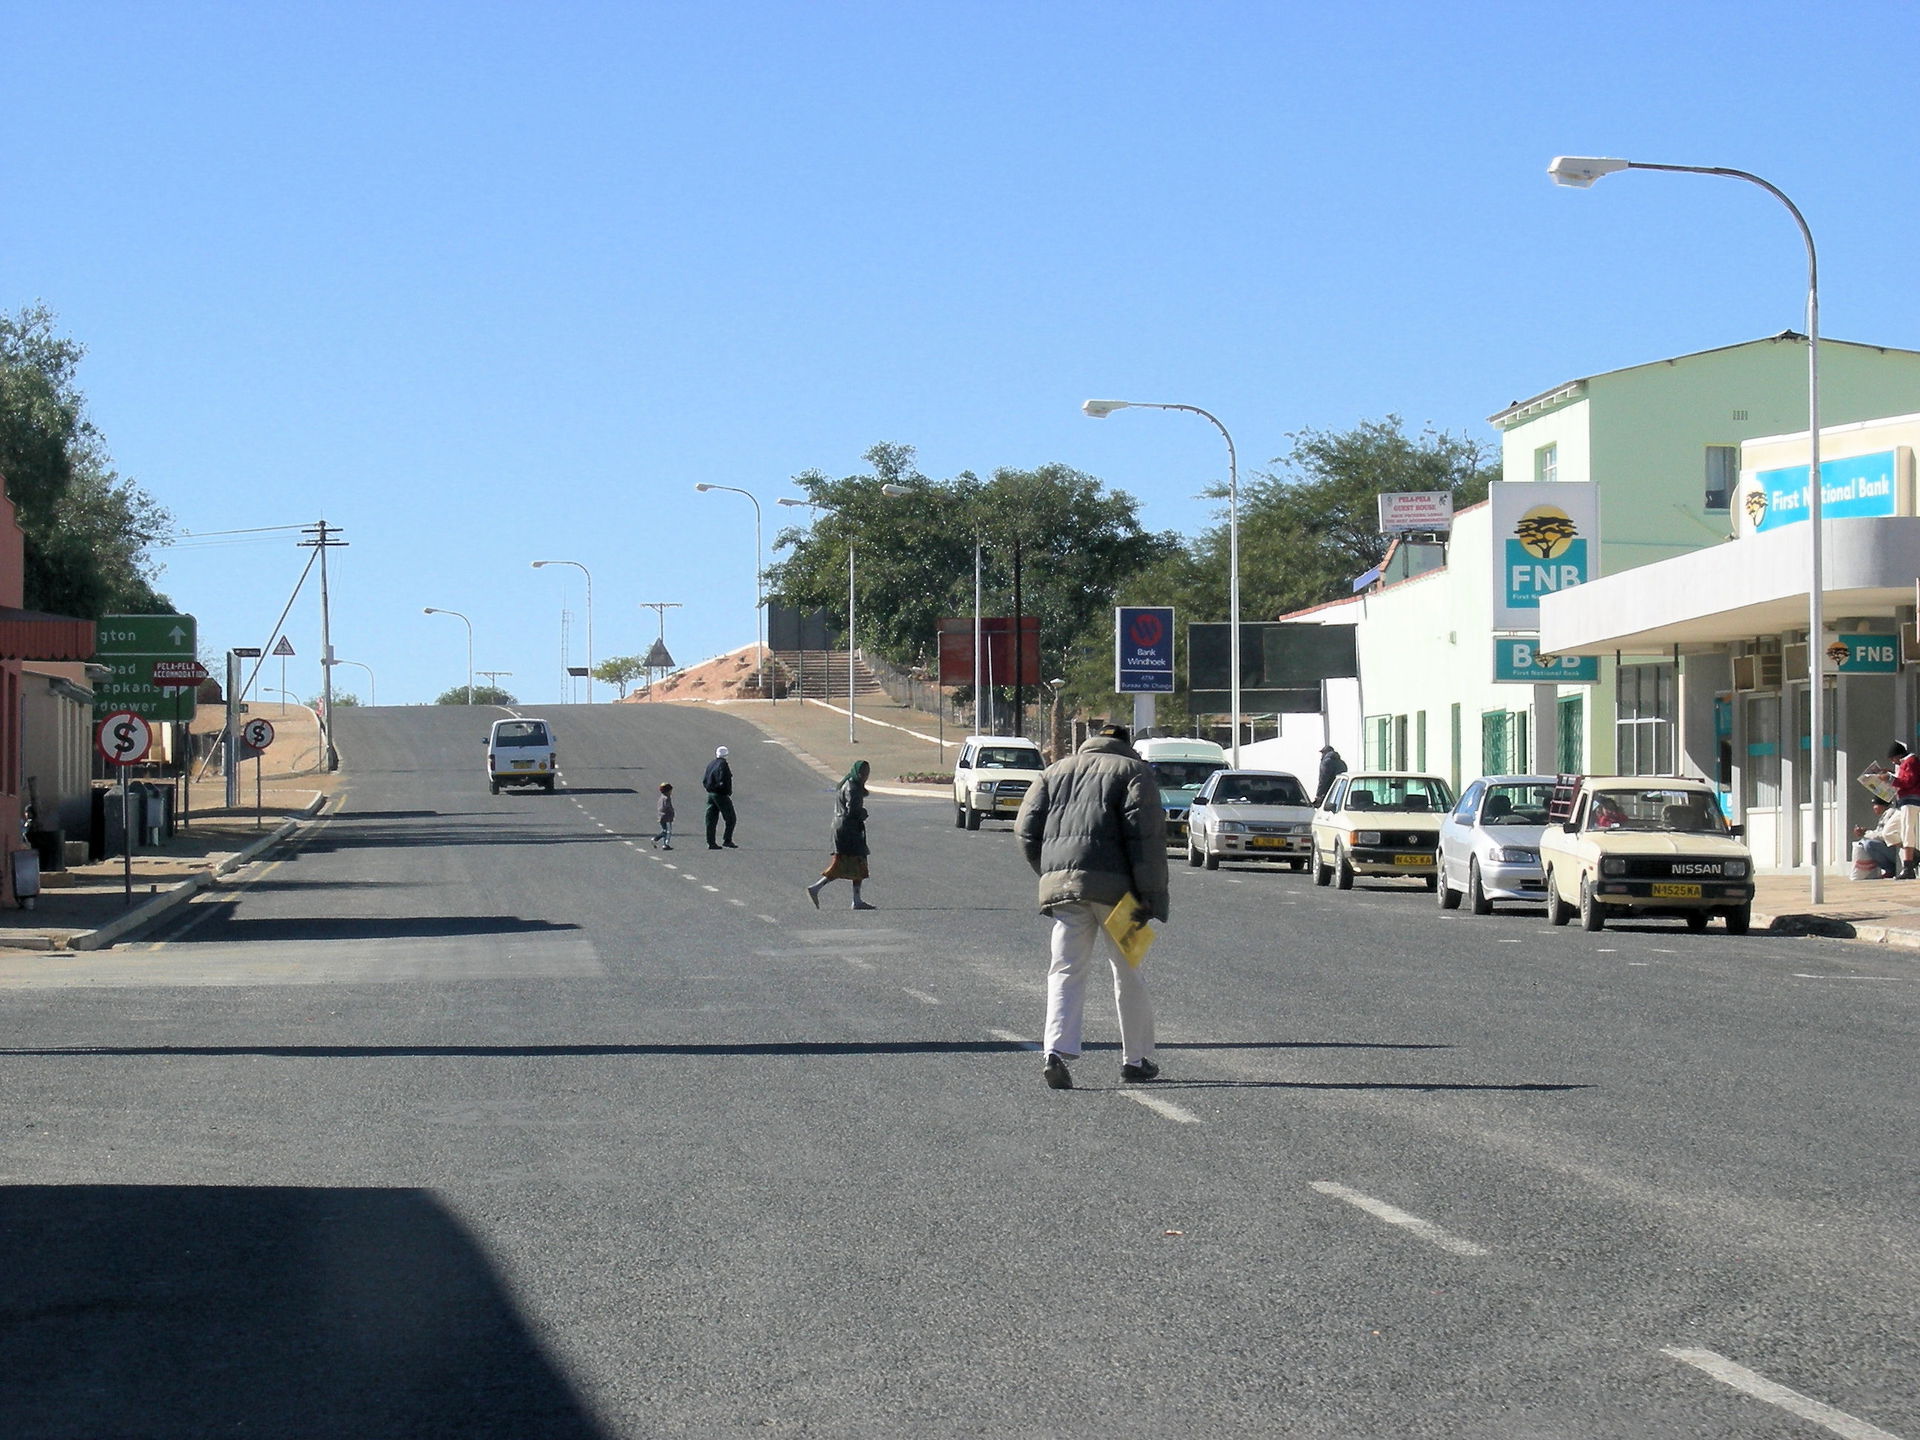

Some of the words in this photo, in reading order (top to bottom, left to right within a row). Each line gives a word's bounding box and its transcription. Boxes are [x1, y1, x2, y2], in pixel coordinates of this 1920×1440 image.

[1772, 489, 1799, 512] First
[1803, 479, 1855, 507] Ntional
[1859, 473, 1890, 498] Bank
[1512, 565, 1581, 592] FNB
[1137, 648, 1156, 656] Bank
[1856, 646, 1894, 663] FNB
[157, 662, 195, 670] PELA-PELA
[1127, 657, 1166, 665] Windhoek
[1671, 864, 1721, 874] NISSAN
